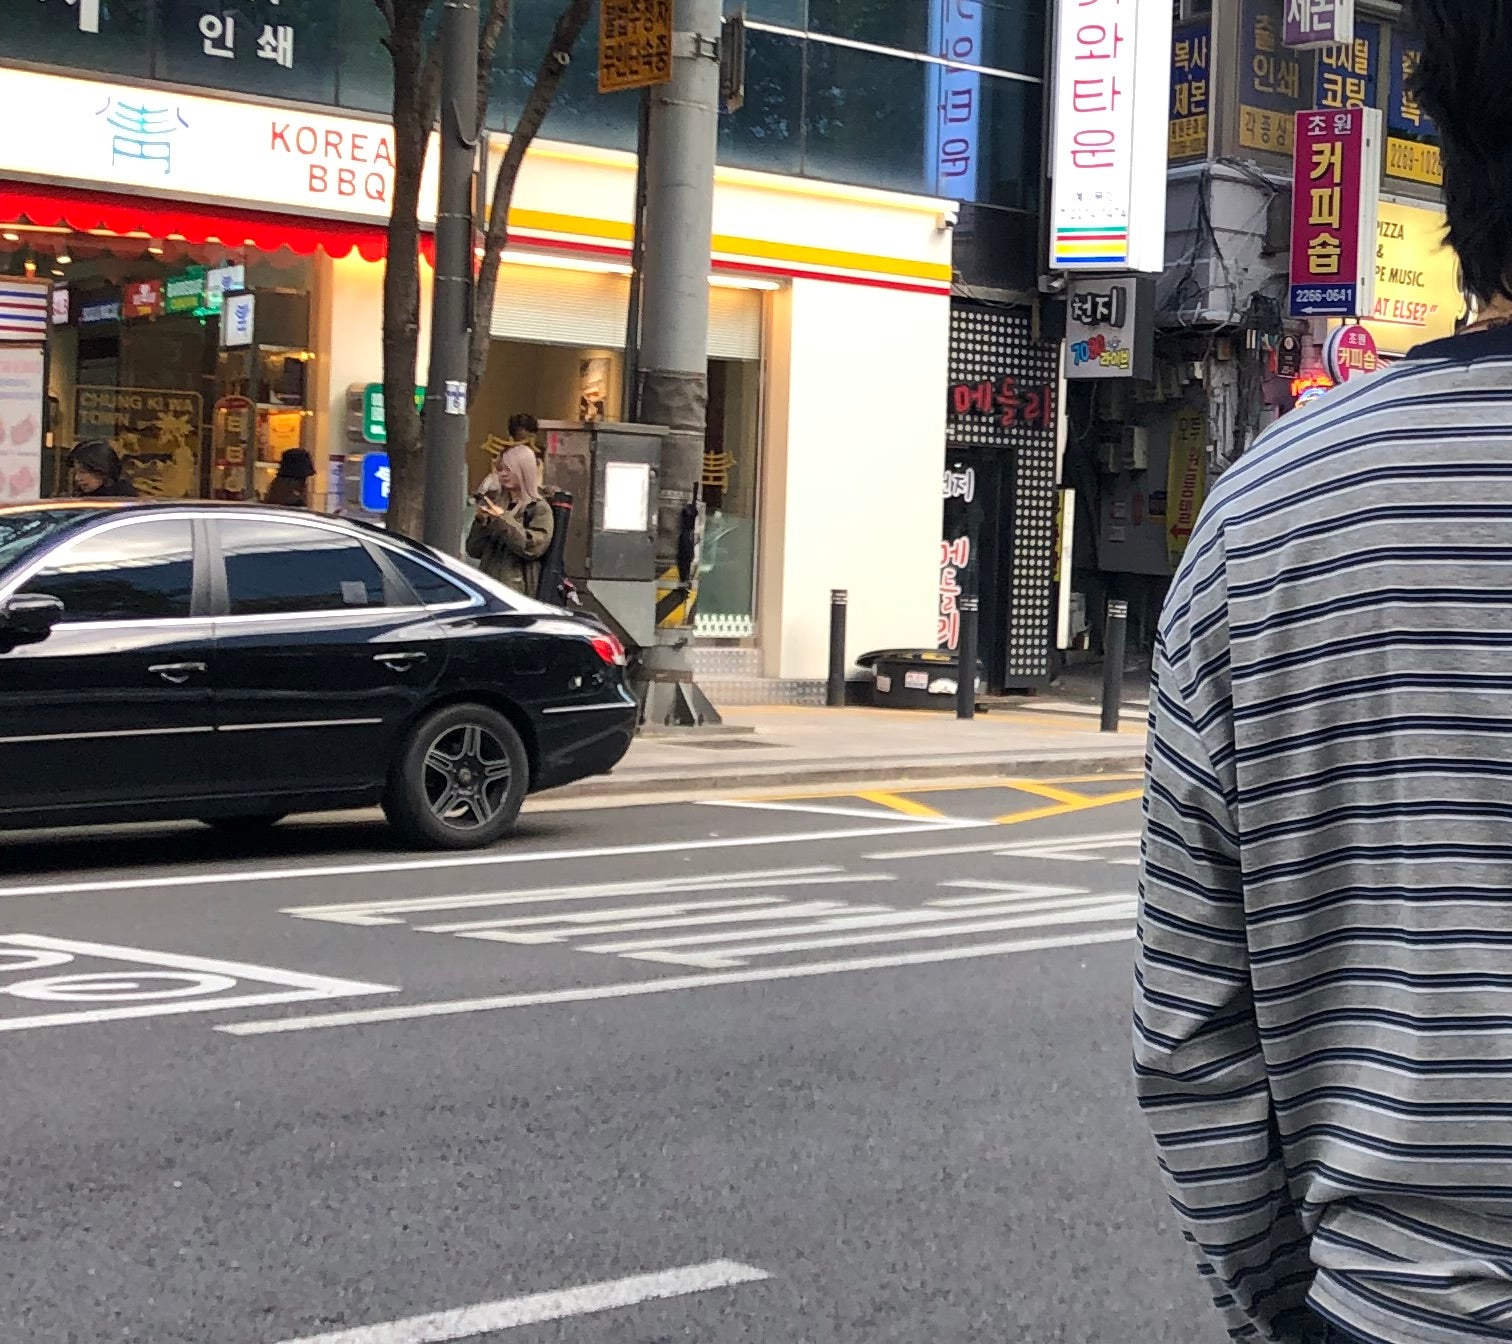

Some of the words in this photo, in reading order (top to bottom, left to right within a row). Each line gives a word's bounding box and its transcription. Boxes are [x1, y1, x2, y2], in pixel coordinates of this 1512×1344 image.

[199, 14, 293, 68] 인쇄
[1174, 36, 1207, 71] 복사
[1253, 55, 1299, 98] 인쇄
[1322, 73, 1366, 109] 코팅
[1173, 80, 1205, 115] 제본
[1307, 114, 1352, 136] 초원
[270, 122, 395, 168] KOREA
[308, 164, 386, 202] BBQ
[1307, 141, 1343, 275] 커피숍
[1072, 286, 1127, 328] 천지
[1374, 297, 1390, 316] AT
[1338, 347, 1376, 370] 커피숍
[953, 376, 1050, 427] 메들리
